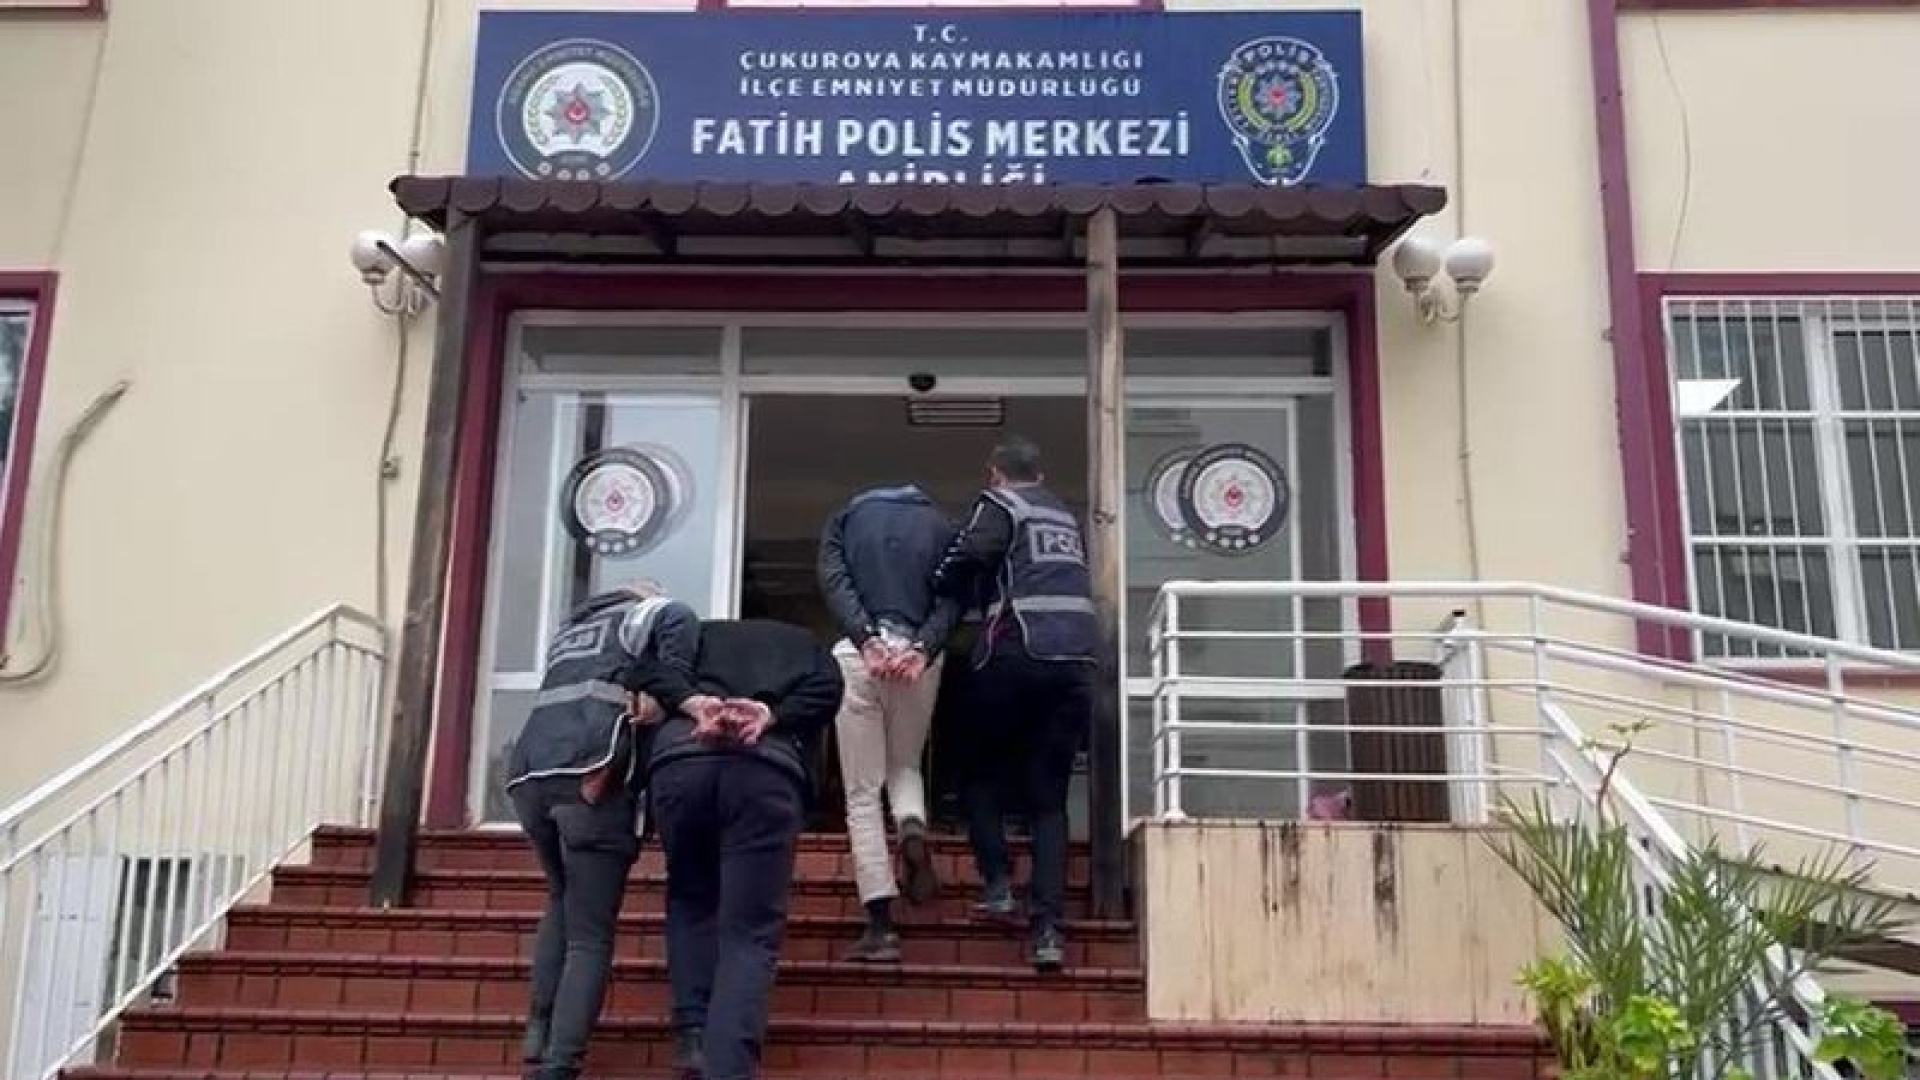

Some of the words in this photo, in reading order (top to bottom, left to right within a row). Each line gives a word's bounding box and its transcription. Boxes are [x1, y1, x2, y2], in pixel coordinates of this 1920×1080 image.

[914, 24, 968, 43] T.C.
[692, 111, 823, 155] FATİH
[837, 110, 974, 156] POLİS
[985, 110, 1190, 156] MERKEZİ
